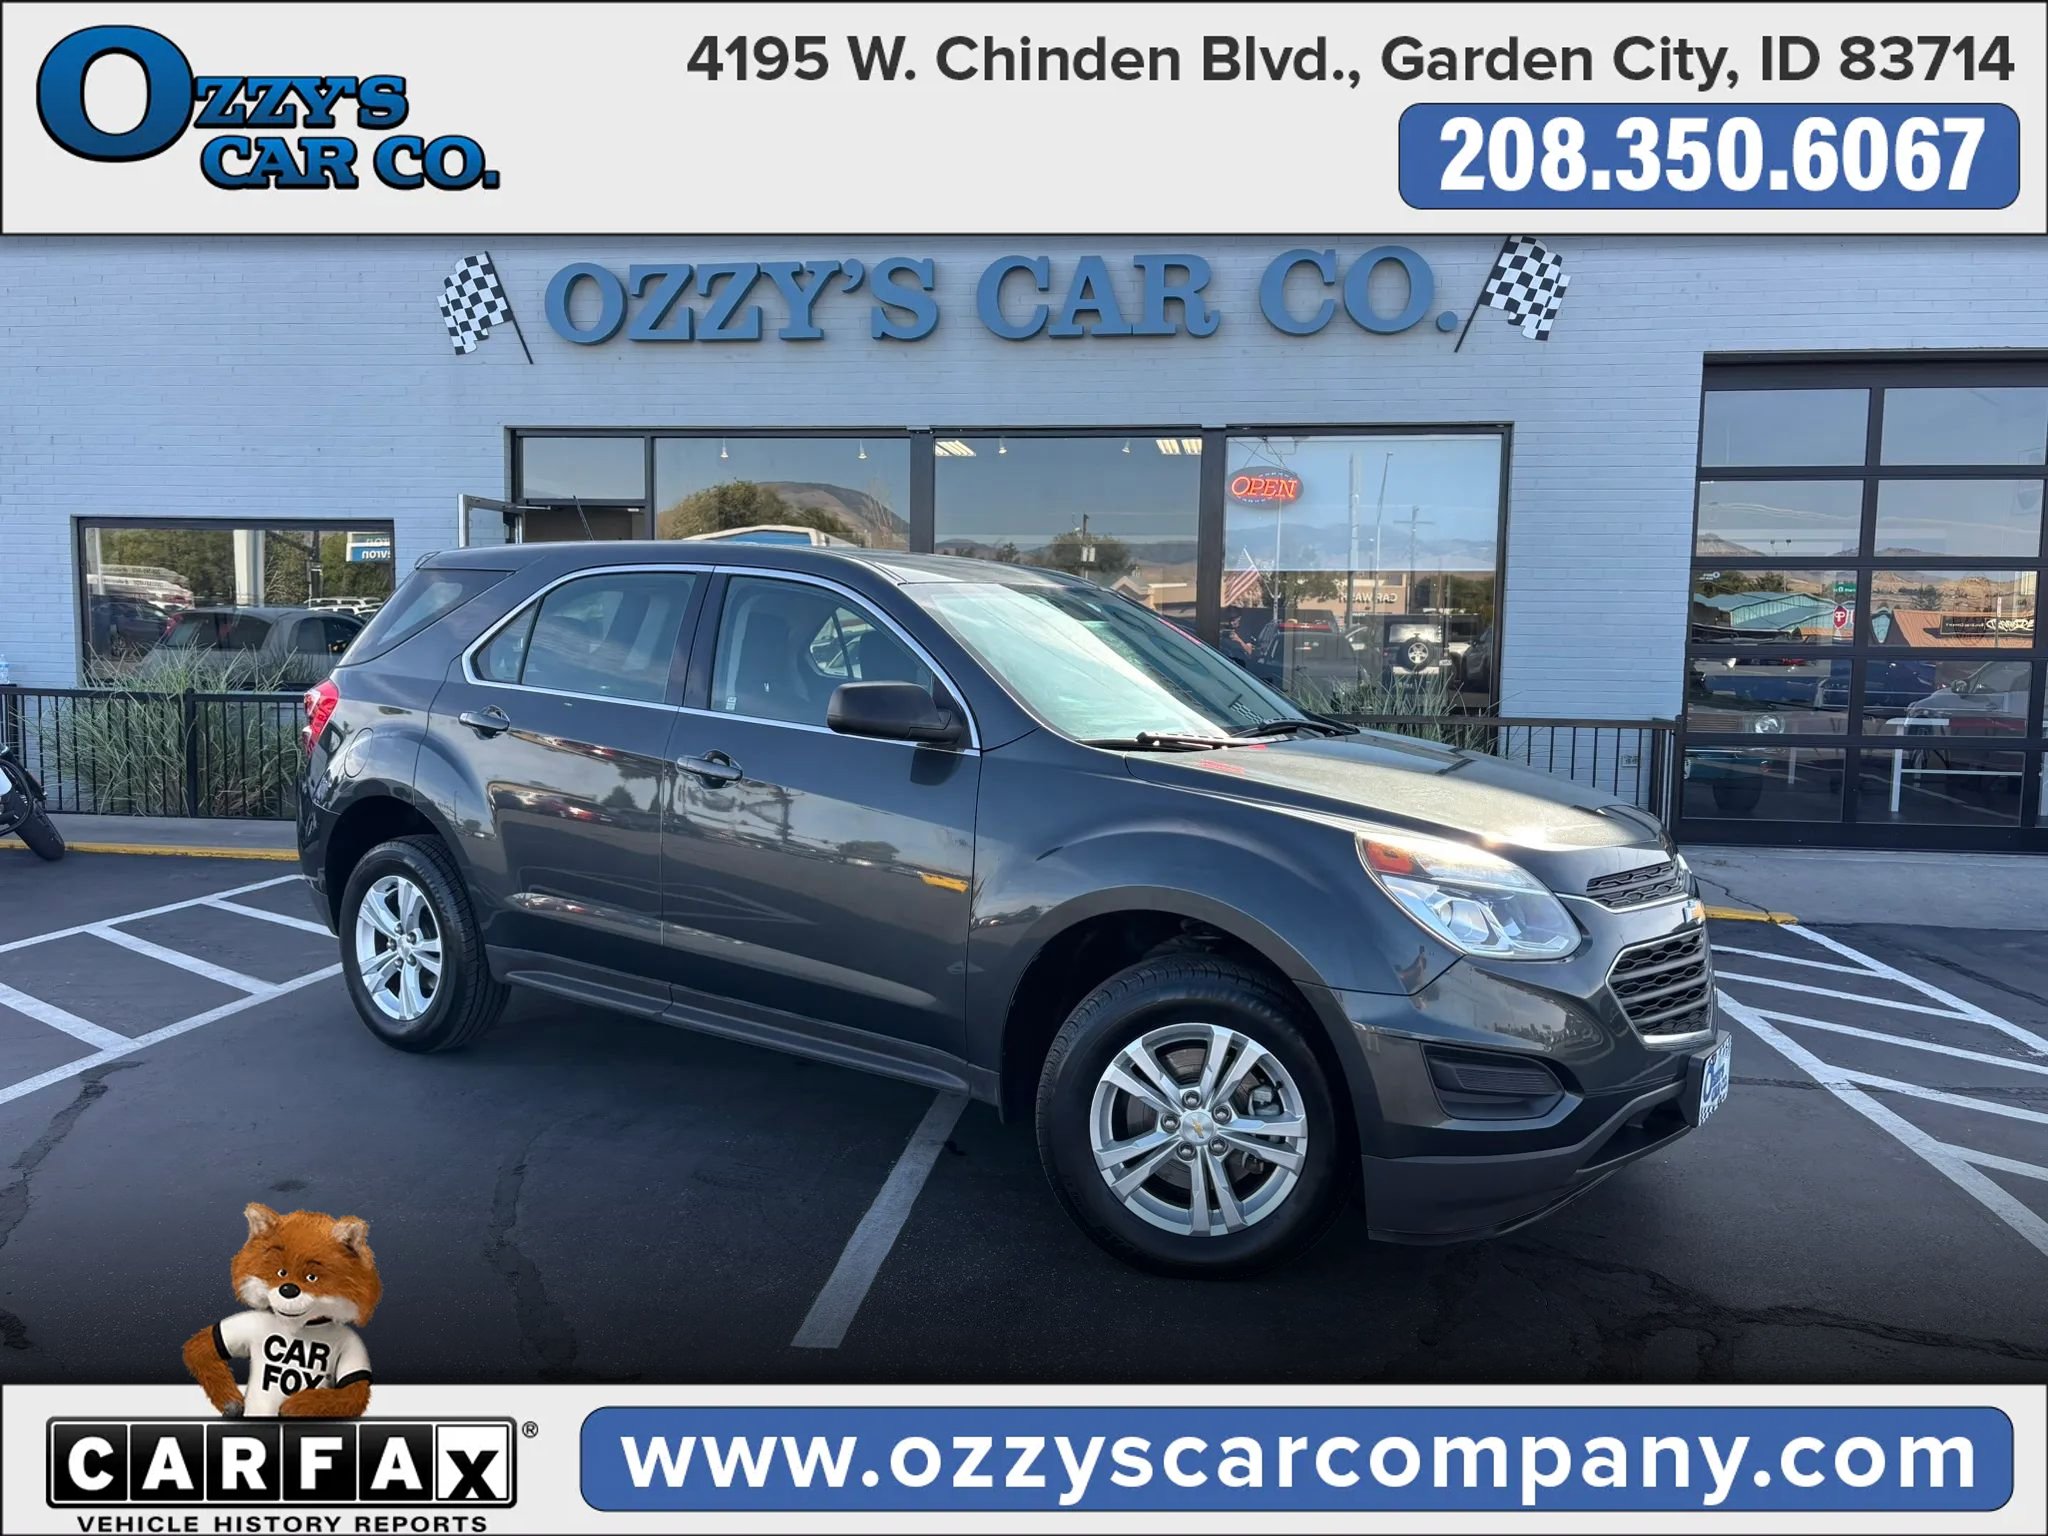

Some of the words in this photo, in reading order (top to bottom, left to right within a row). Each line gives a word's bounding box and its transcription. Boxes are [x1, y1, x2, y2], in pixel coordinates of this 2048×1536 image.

[544, 257, 939, 345] OZZY'S
[976, 254, 1220, 340] CAR
[1259, 245, 1458, 336] CO.
[1231, 475, 1298, 498] OPEN
